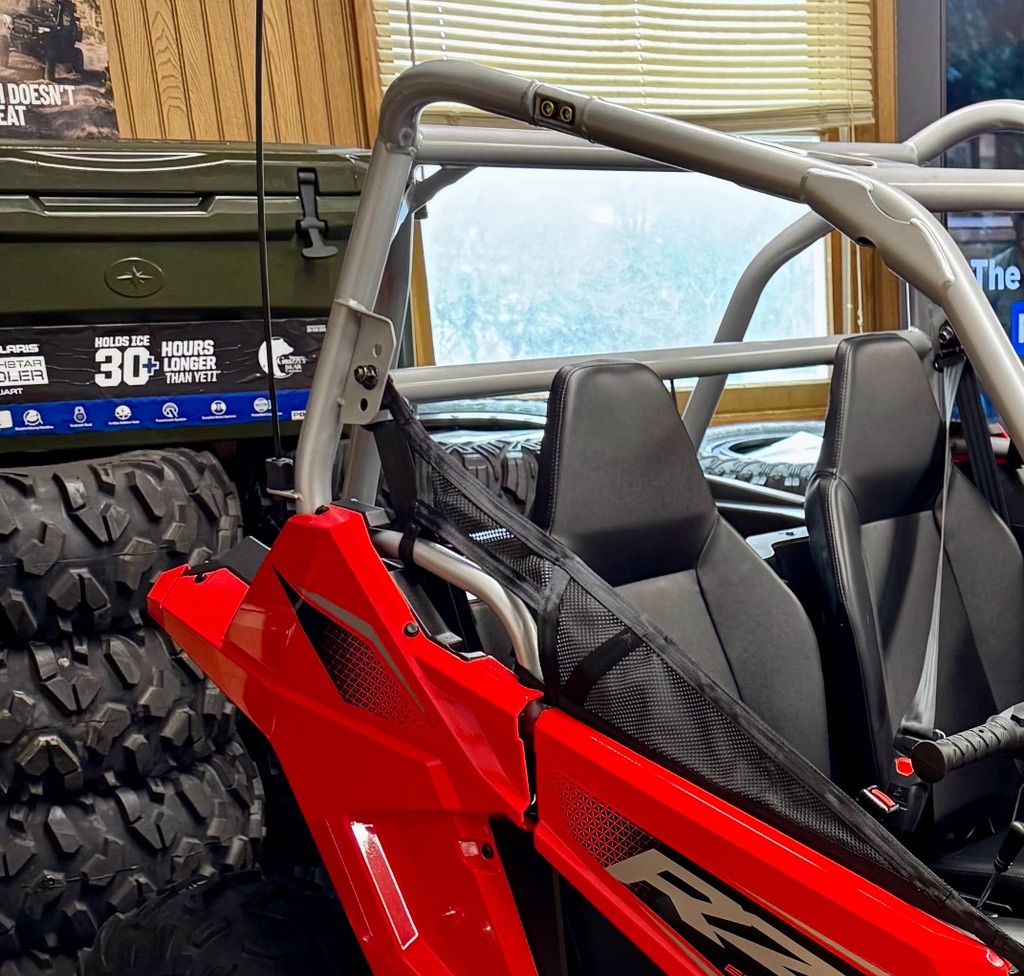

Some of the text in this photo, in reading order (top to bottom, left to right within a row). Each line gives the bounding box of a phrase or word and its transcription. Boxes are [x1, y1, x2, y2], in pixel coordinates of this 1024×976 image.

[7, 83, 75, 106] DOESN'T
[970, 258, 1020, 291] The
[94, 335, 151, 348] HOLDS ICE
[161, 340, 215, 357] HOURS
[163, 356, 217, 372] LONGER
[165, 371, 218, 384] THAN YETI
